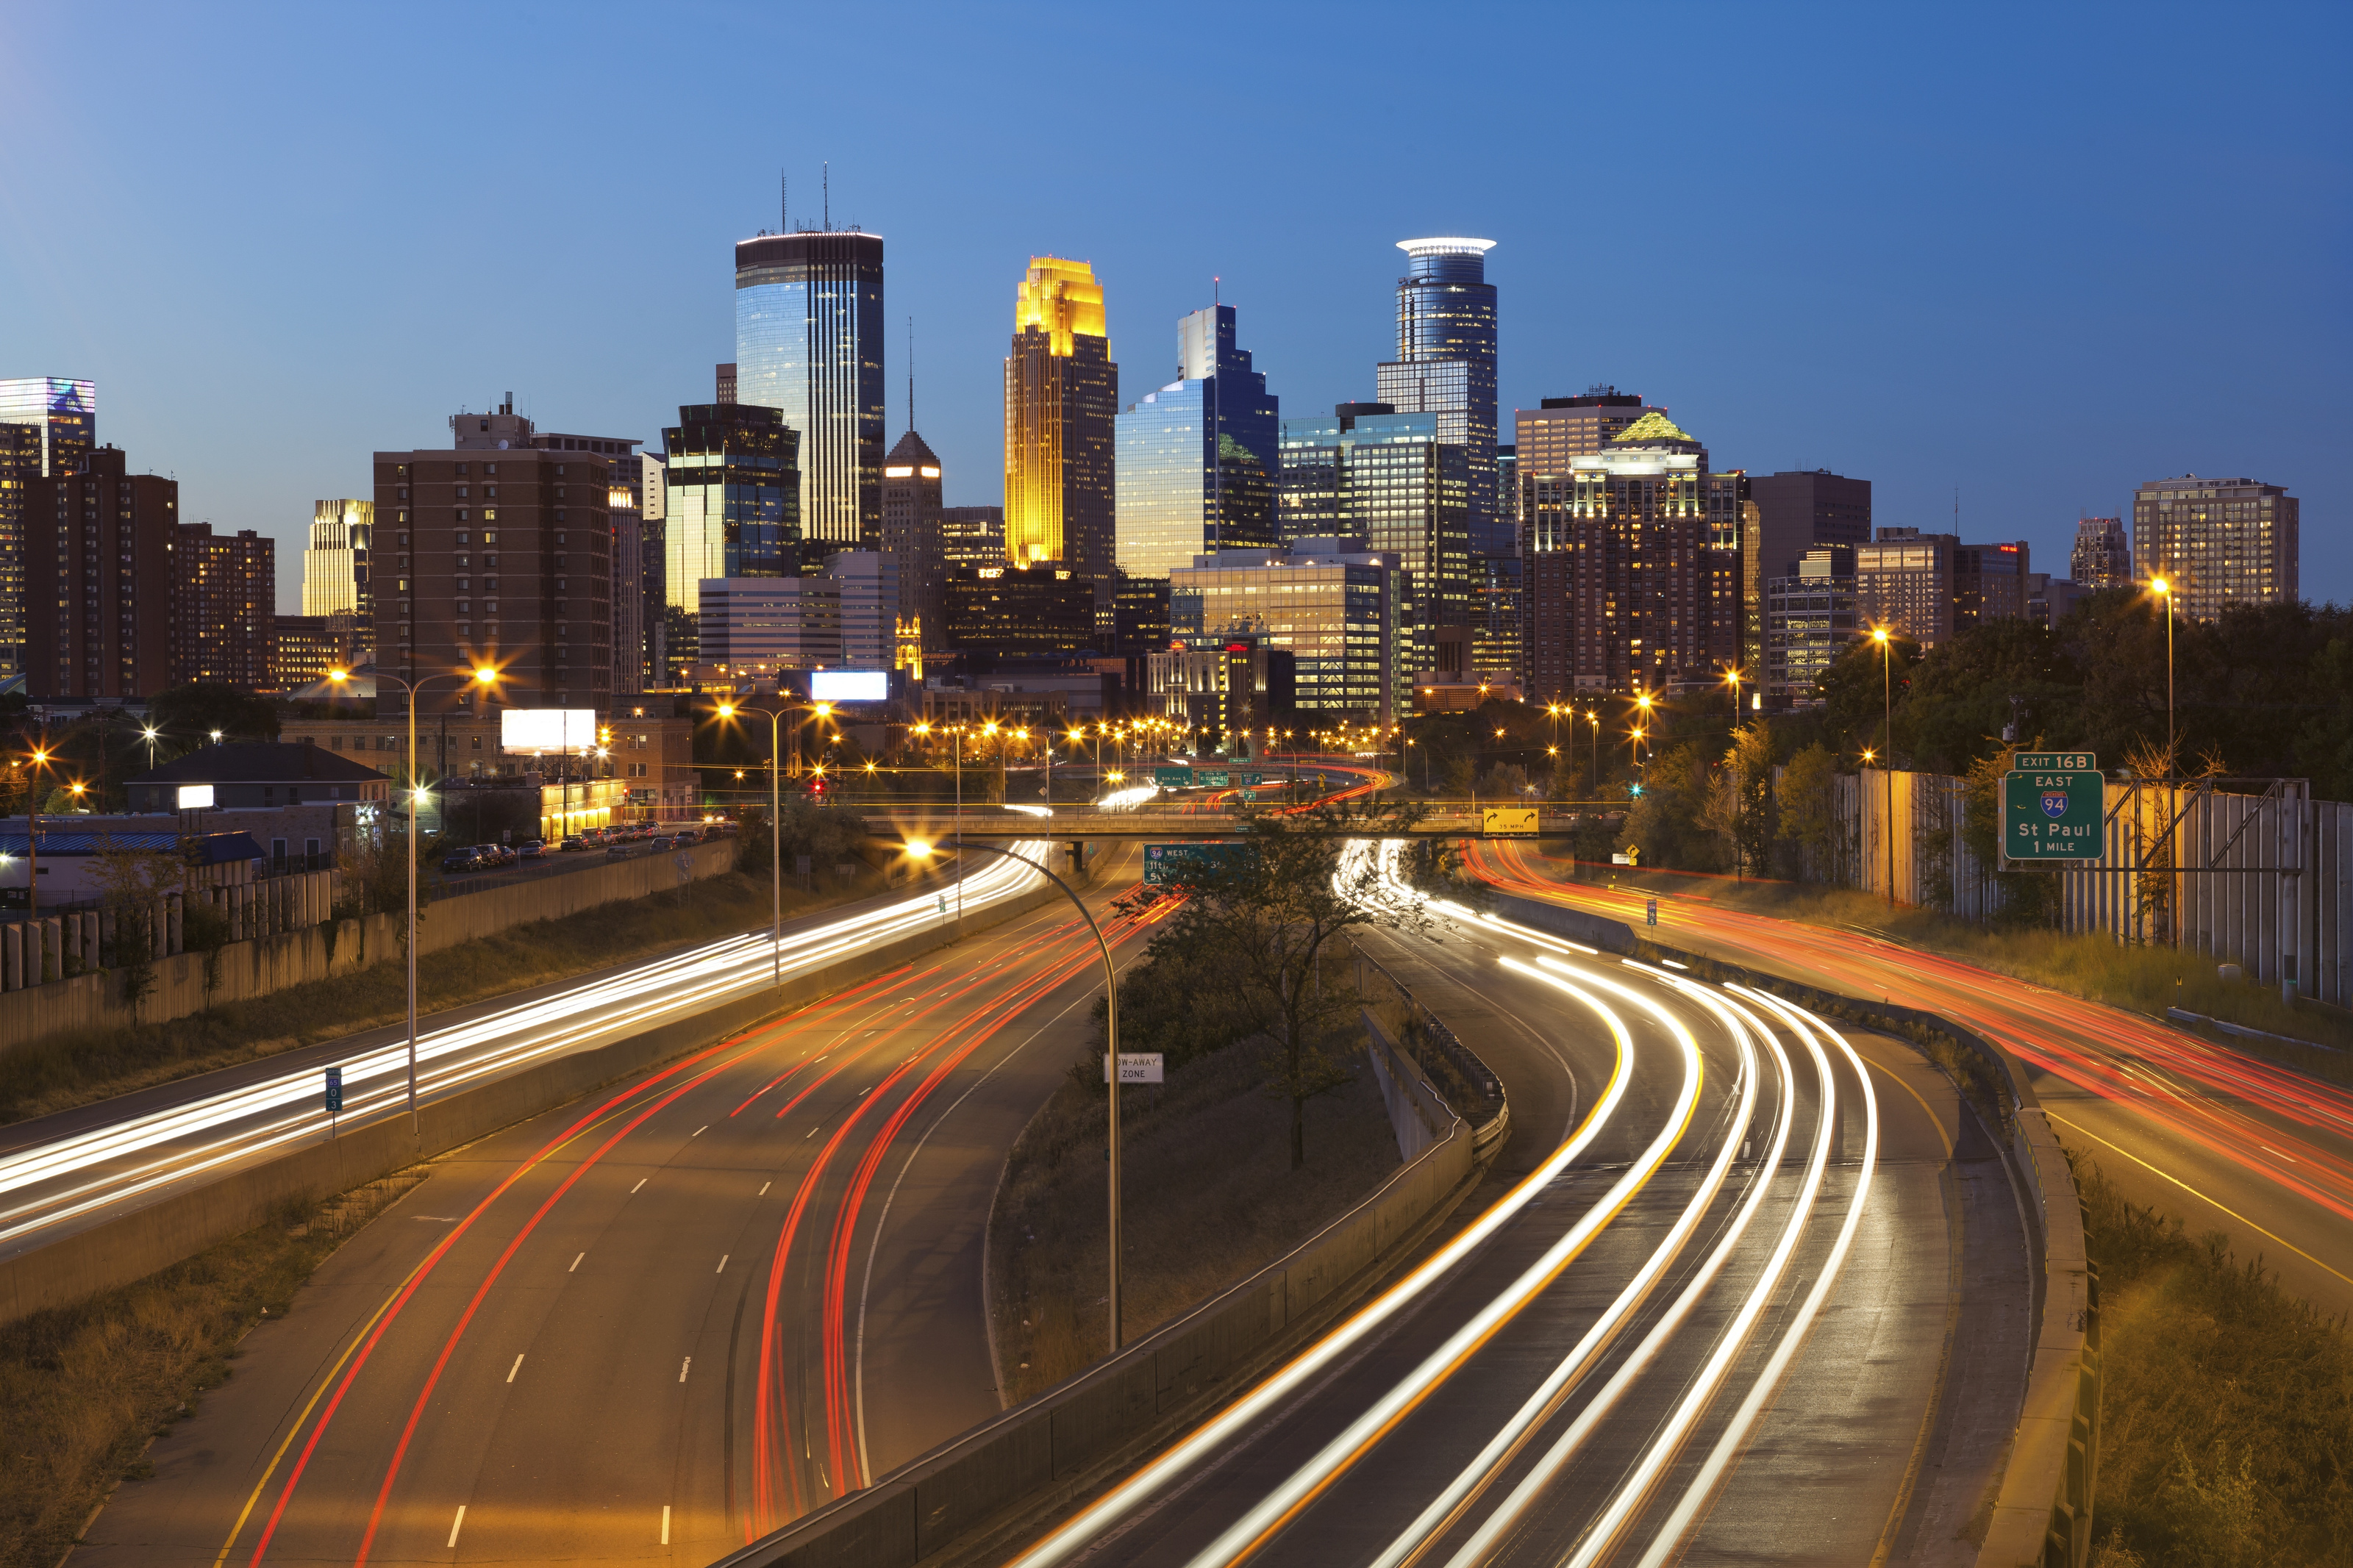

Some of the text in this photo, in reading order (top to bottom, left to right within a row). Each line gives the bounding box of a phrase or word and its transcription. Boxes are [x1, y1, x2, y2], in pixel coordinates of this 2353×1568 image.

[2022, 756, 2087, 768] EXIT 16B
[2035, 776, 2073, 787] EAST
[2045, 798, 2064, 811] 94
[2019, 823, 2090, 836] St Paul
[2034, 841, 2075, 853] 1 MILE
[331, 1089, 337, 1097] 0
